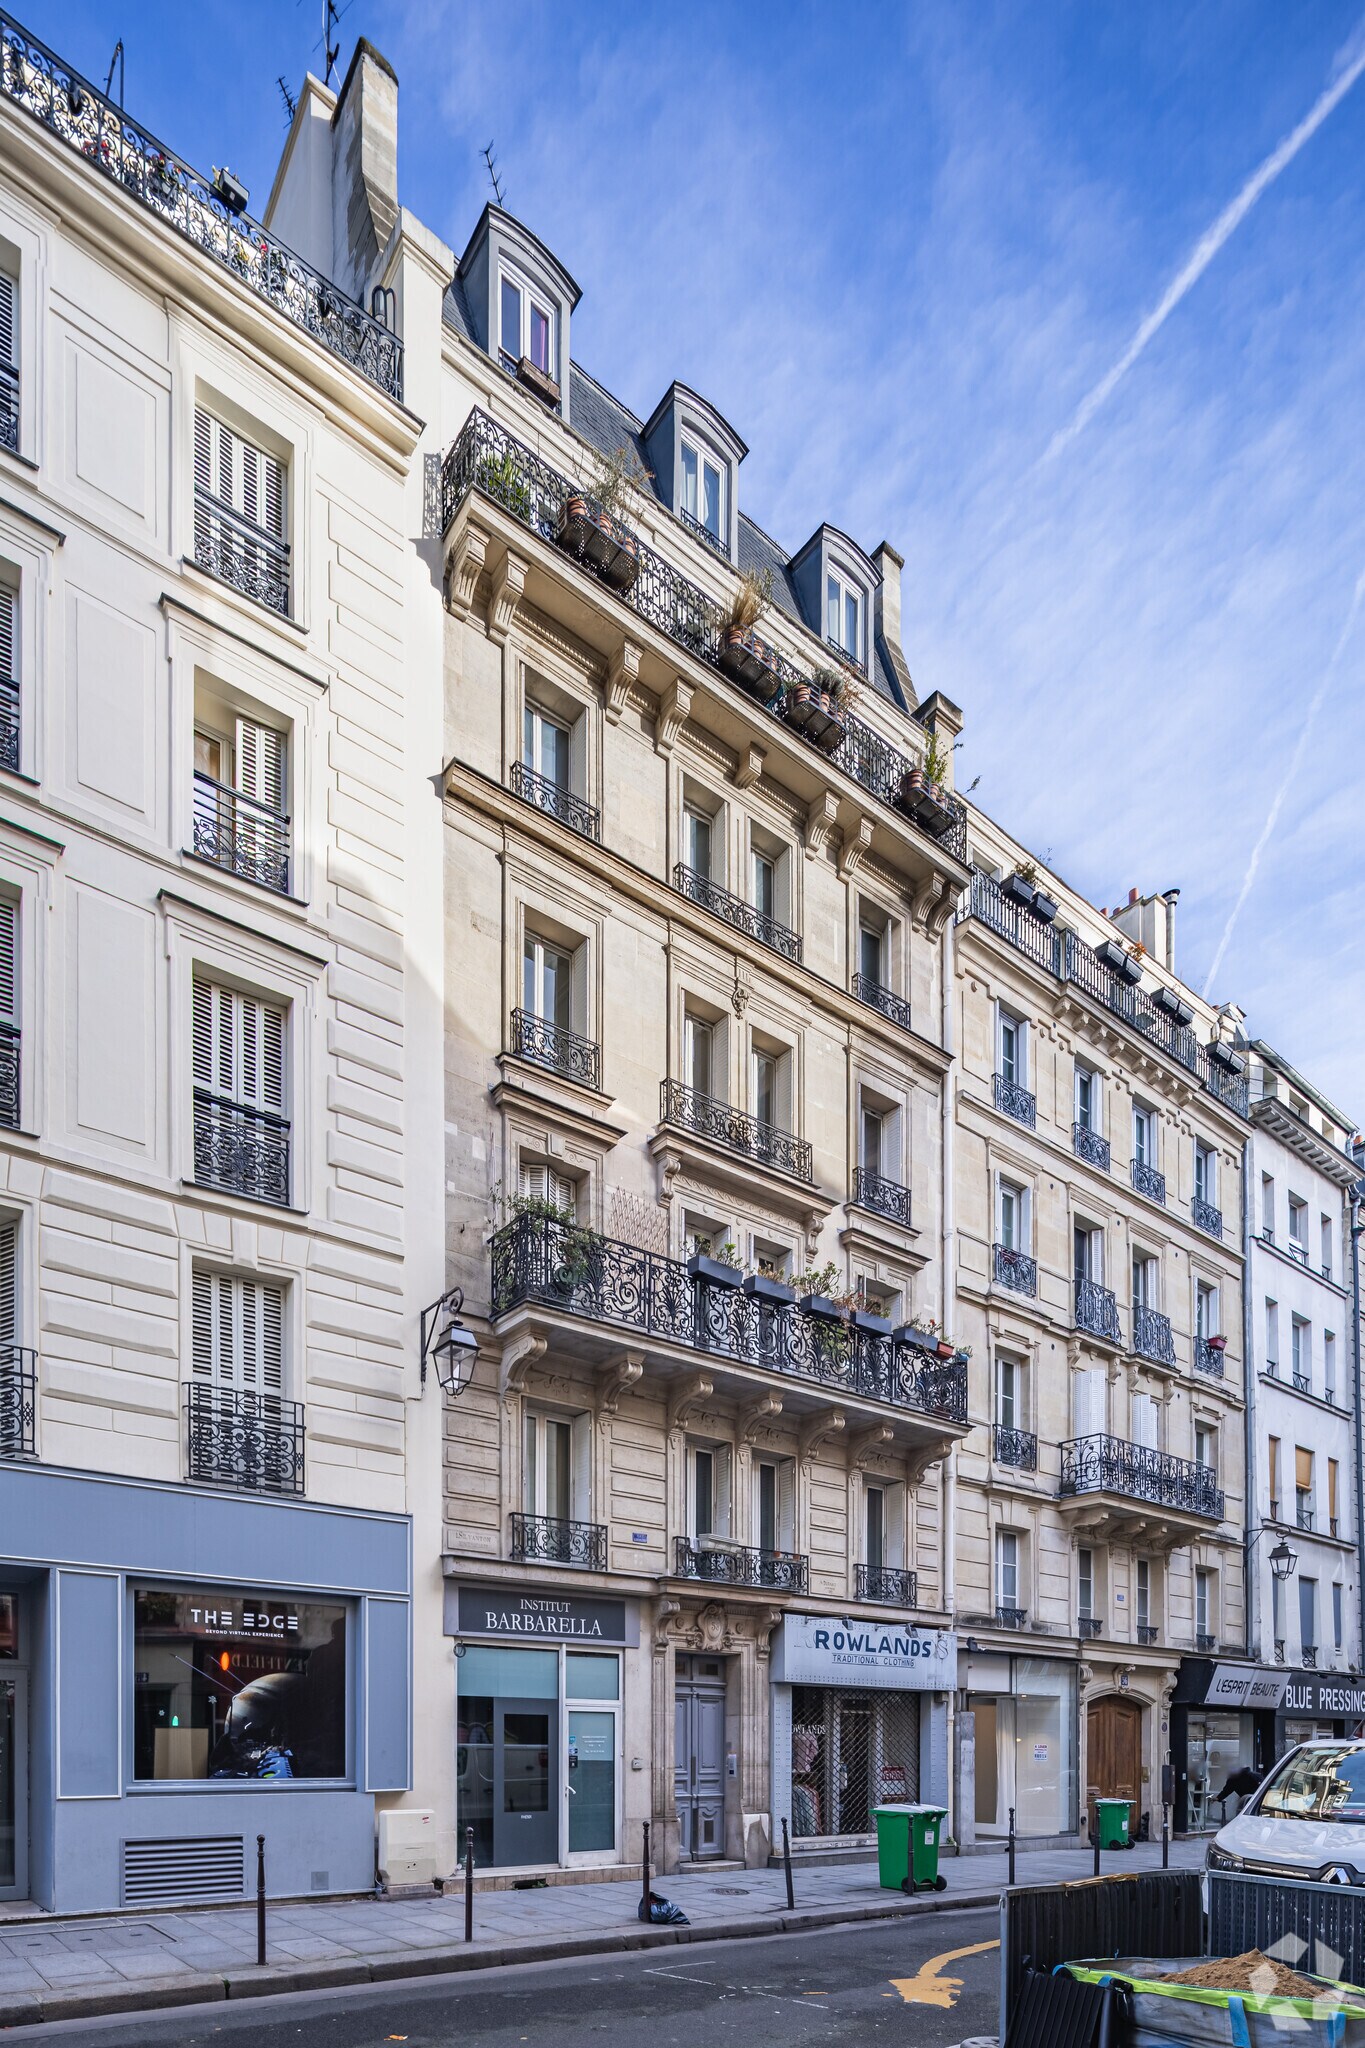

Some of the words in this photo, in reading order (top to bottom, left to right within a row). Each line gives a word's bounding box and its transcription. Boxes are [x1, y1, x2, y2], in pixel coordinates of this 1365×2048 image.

[520, 1598, 571, 1613] INSTITUT
[190, 1608, 233, 1626] THE
[243, 1613, 298, 1630] EDGE
[485, 1611, 603, 1636] BARBARELLA
[205, 1628, 228, 1636] BEYOND
[815, 1629, 932, 1658] ROWLANDS
[833, 1654, 879, 1665] TRADITIONAL
[883, 1657, 915, 1667] CLOTHING
[1216, 1678, 1250, 1695] L'ESPRIT
[1250, 1682, 1280, 1697] BEAUTE
[1286, 1685, 1312, 1709] BLUE
